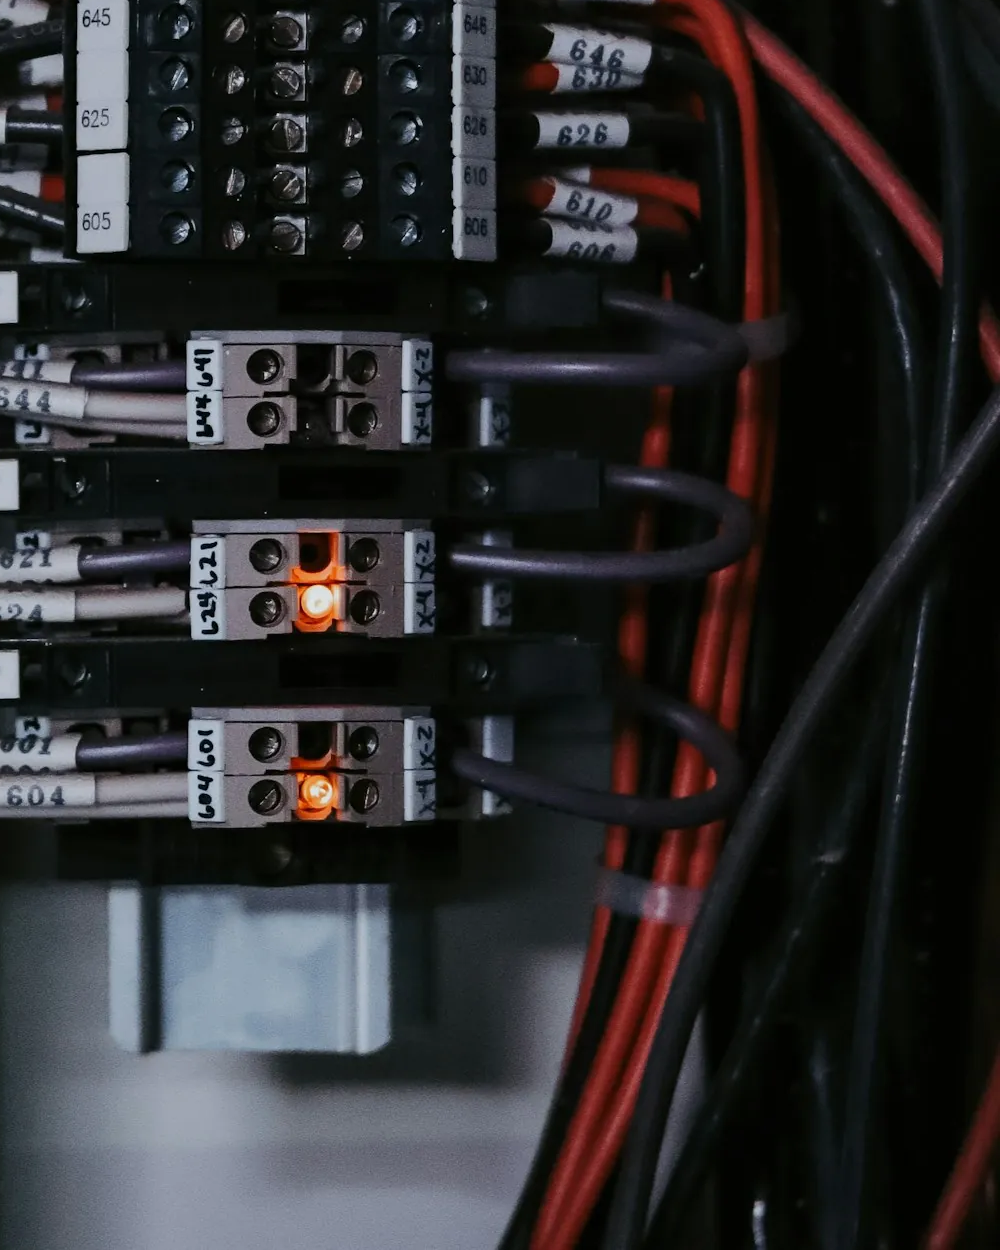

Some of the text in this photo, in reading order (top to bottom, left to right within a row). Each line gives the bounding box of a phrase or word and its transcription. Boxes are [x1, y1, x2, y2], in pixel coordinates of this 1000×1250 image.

[82, 8, 111, 28] 645
[463, 14, 488, 36] 646
[570, 39, 626, 69] 646
[463, 65, 488, 86] 630
[80, 108, 110, 129] 625
[463, 116, 488, 137] 626
[557, 122, 609, 147] 626
[463, 165, 488, 186] 610
[566, 190, 613, 222] 610
[81, 212, 111, 232] 605
[463, 216, 488, 237] 606
[193, 348, 215, 387] 641
[194, 395, 215, 438] 644
[199, 541, 219, 585] 621
[197, 591, 219, 635] 624
[197, 729, 215, 767] 601
[6, 785, 65, 806] 604
[197, 775, 215, 819] 604
